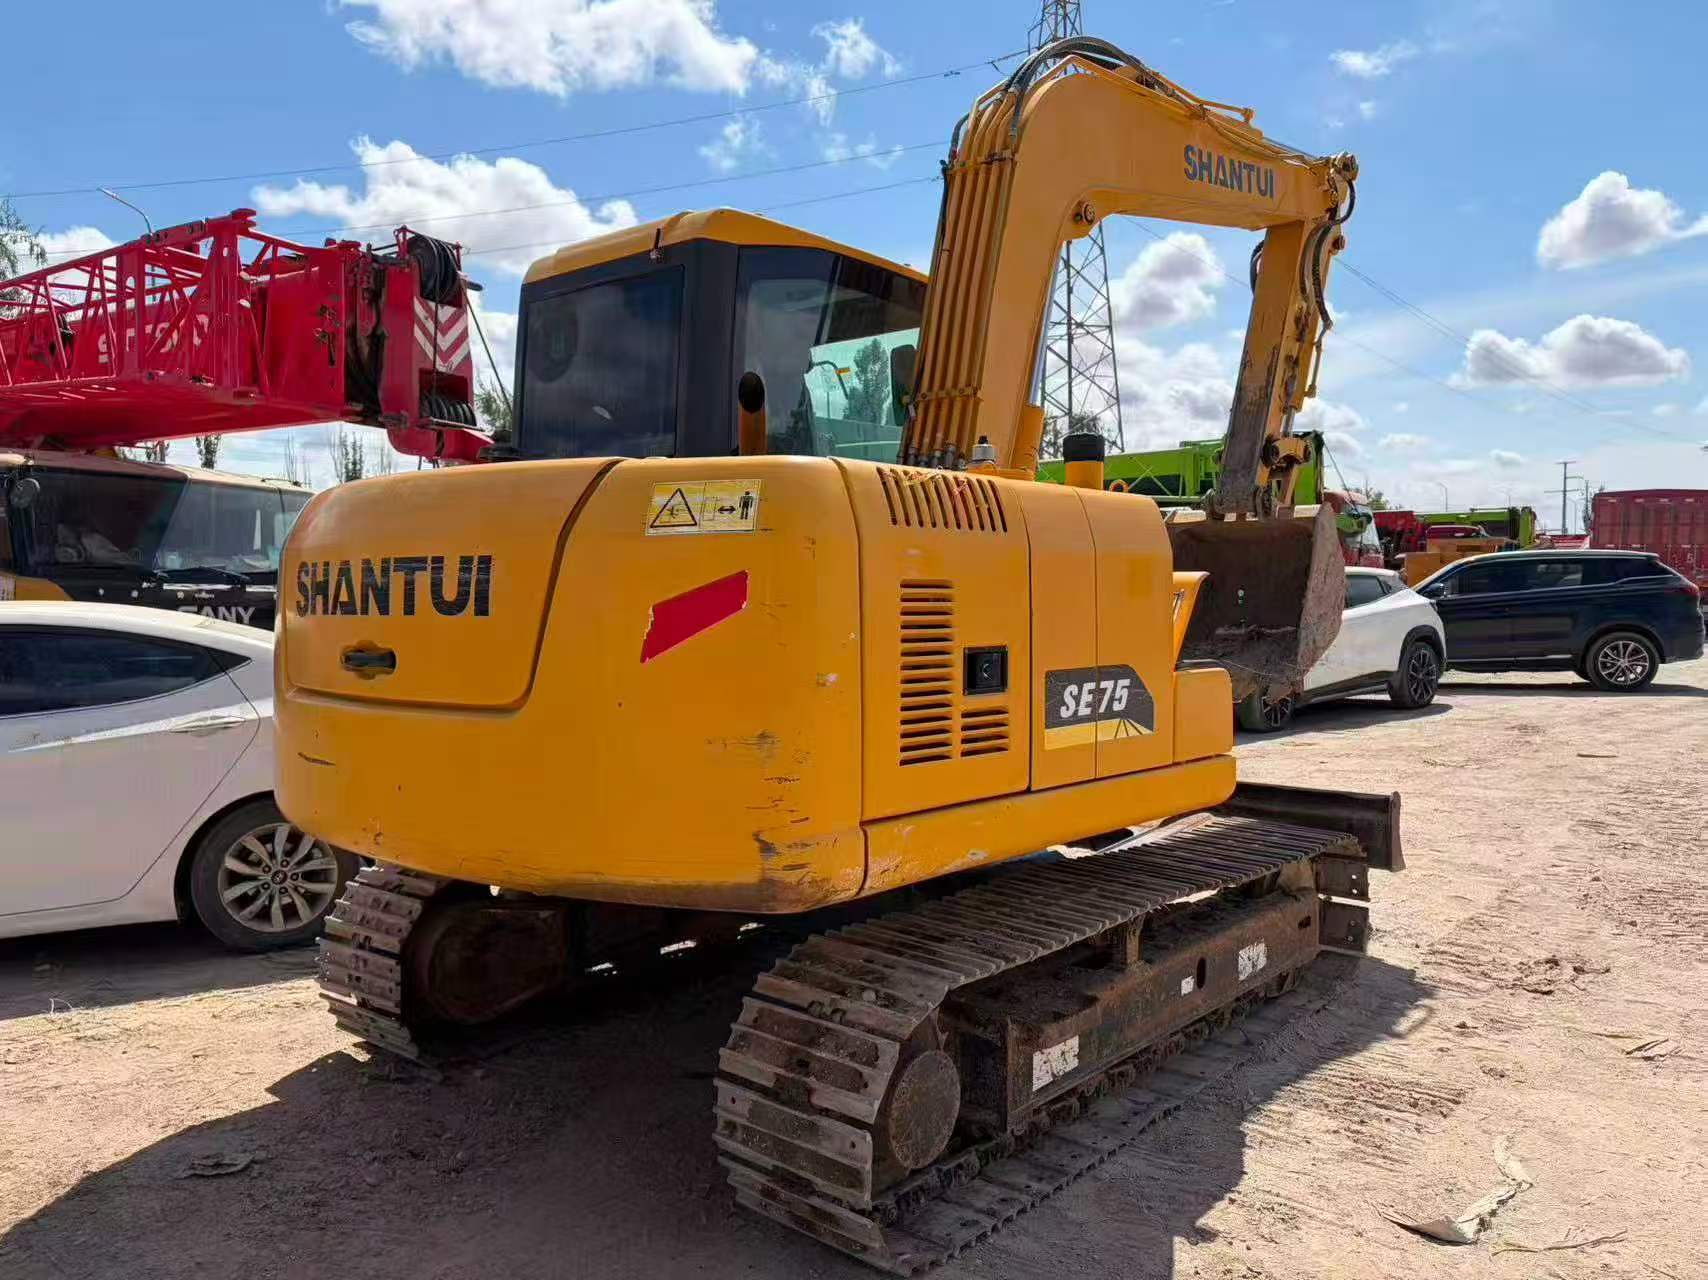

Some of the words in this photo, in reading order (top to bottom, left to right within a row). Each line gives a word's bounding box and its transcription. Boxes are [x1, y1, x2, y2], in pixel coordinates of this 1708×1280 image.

[1184, 145, 1274, 199] SHANTUI
[296, 555, 492, 617] SHANTUI
[1060, 679, 1130, 718] SE75
